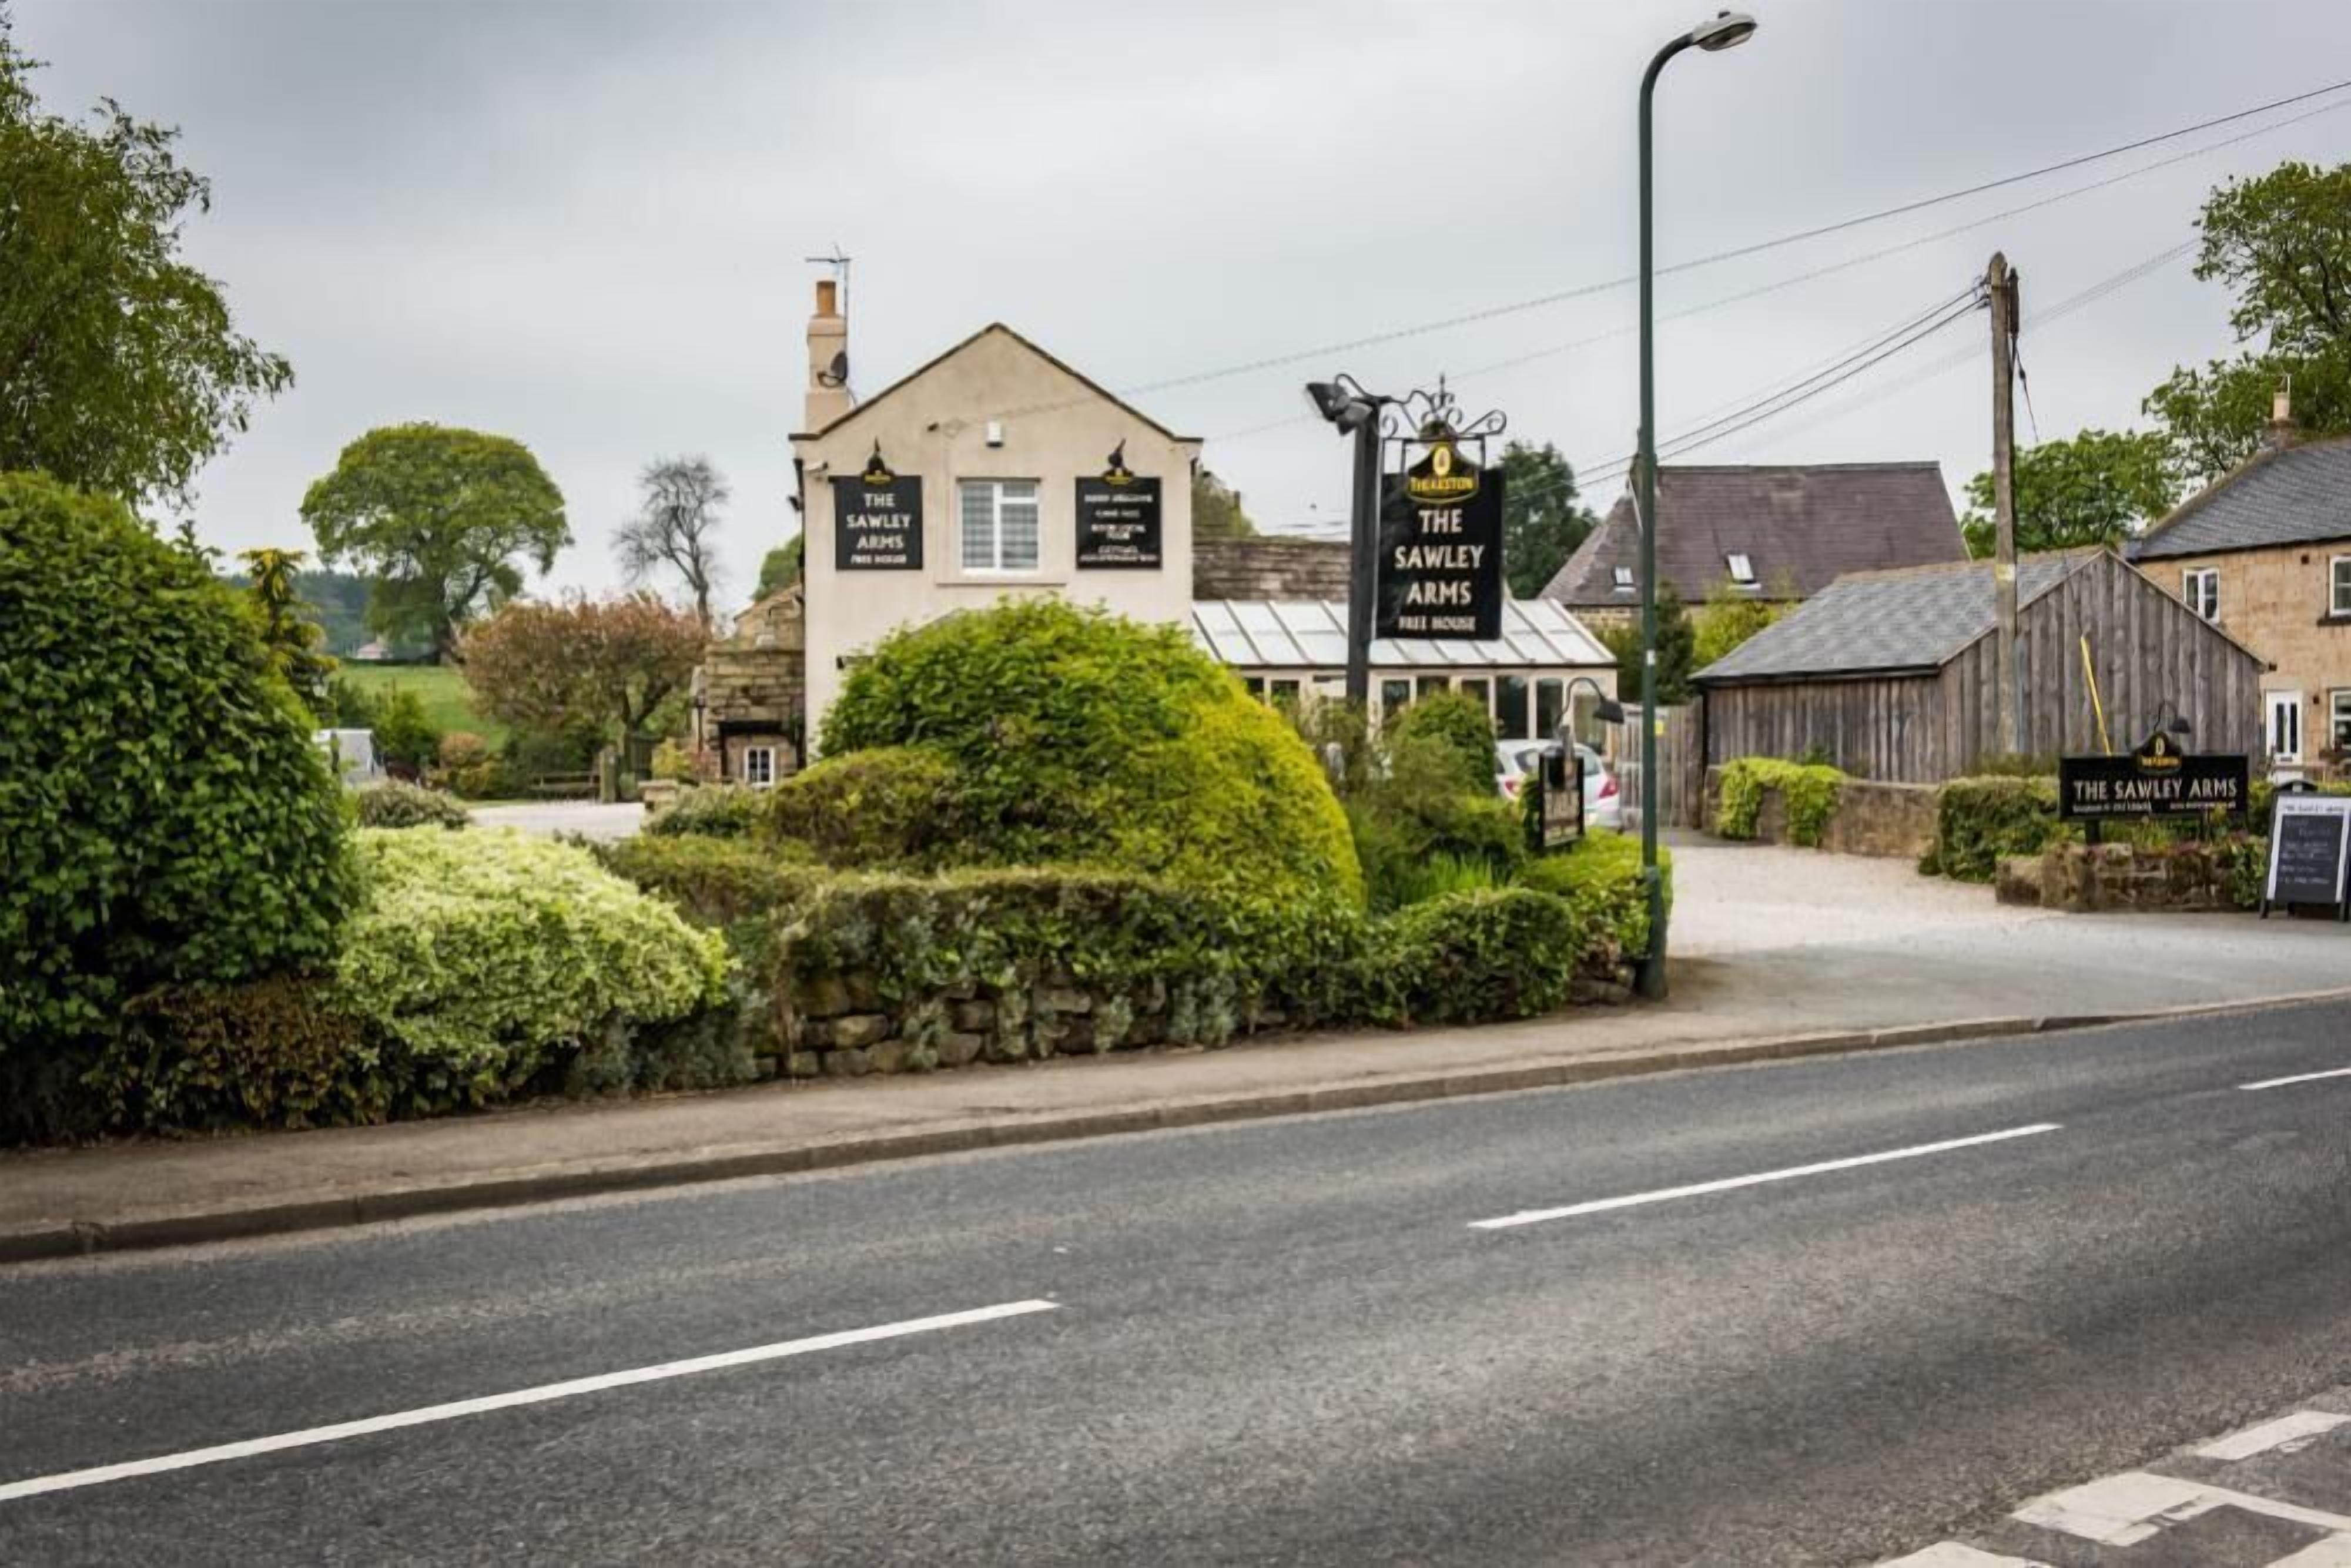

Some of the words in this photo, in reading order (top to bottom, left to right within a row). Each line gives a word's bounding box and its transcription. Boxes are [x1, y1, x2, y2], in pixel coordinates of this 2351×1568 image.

[864, 493, 895, 507] THE
[1419, 509, 1462, 534] THE
[856, 535, 904, 550] ARMS
[1395, 545, 1484, 569] SAWLEY
[1406, 581, 1472, 605] ARMS
[2073, 780, 2108, 800] THE
[2114, 779, 2182, 799] SAWLEY
[2189, 777, 2237, 797] ARMS
